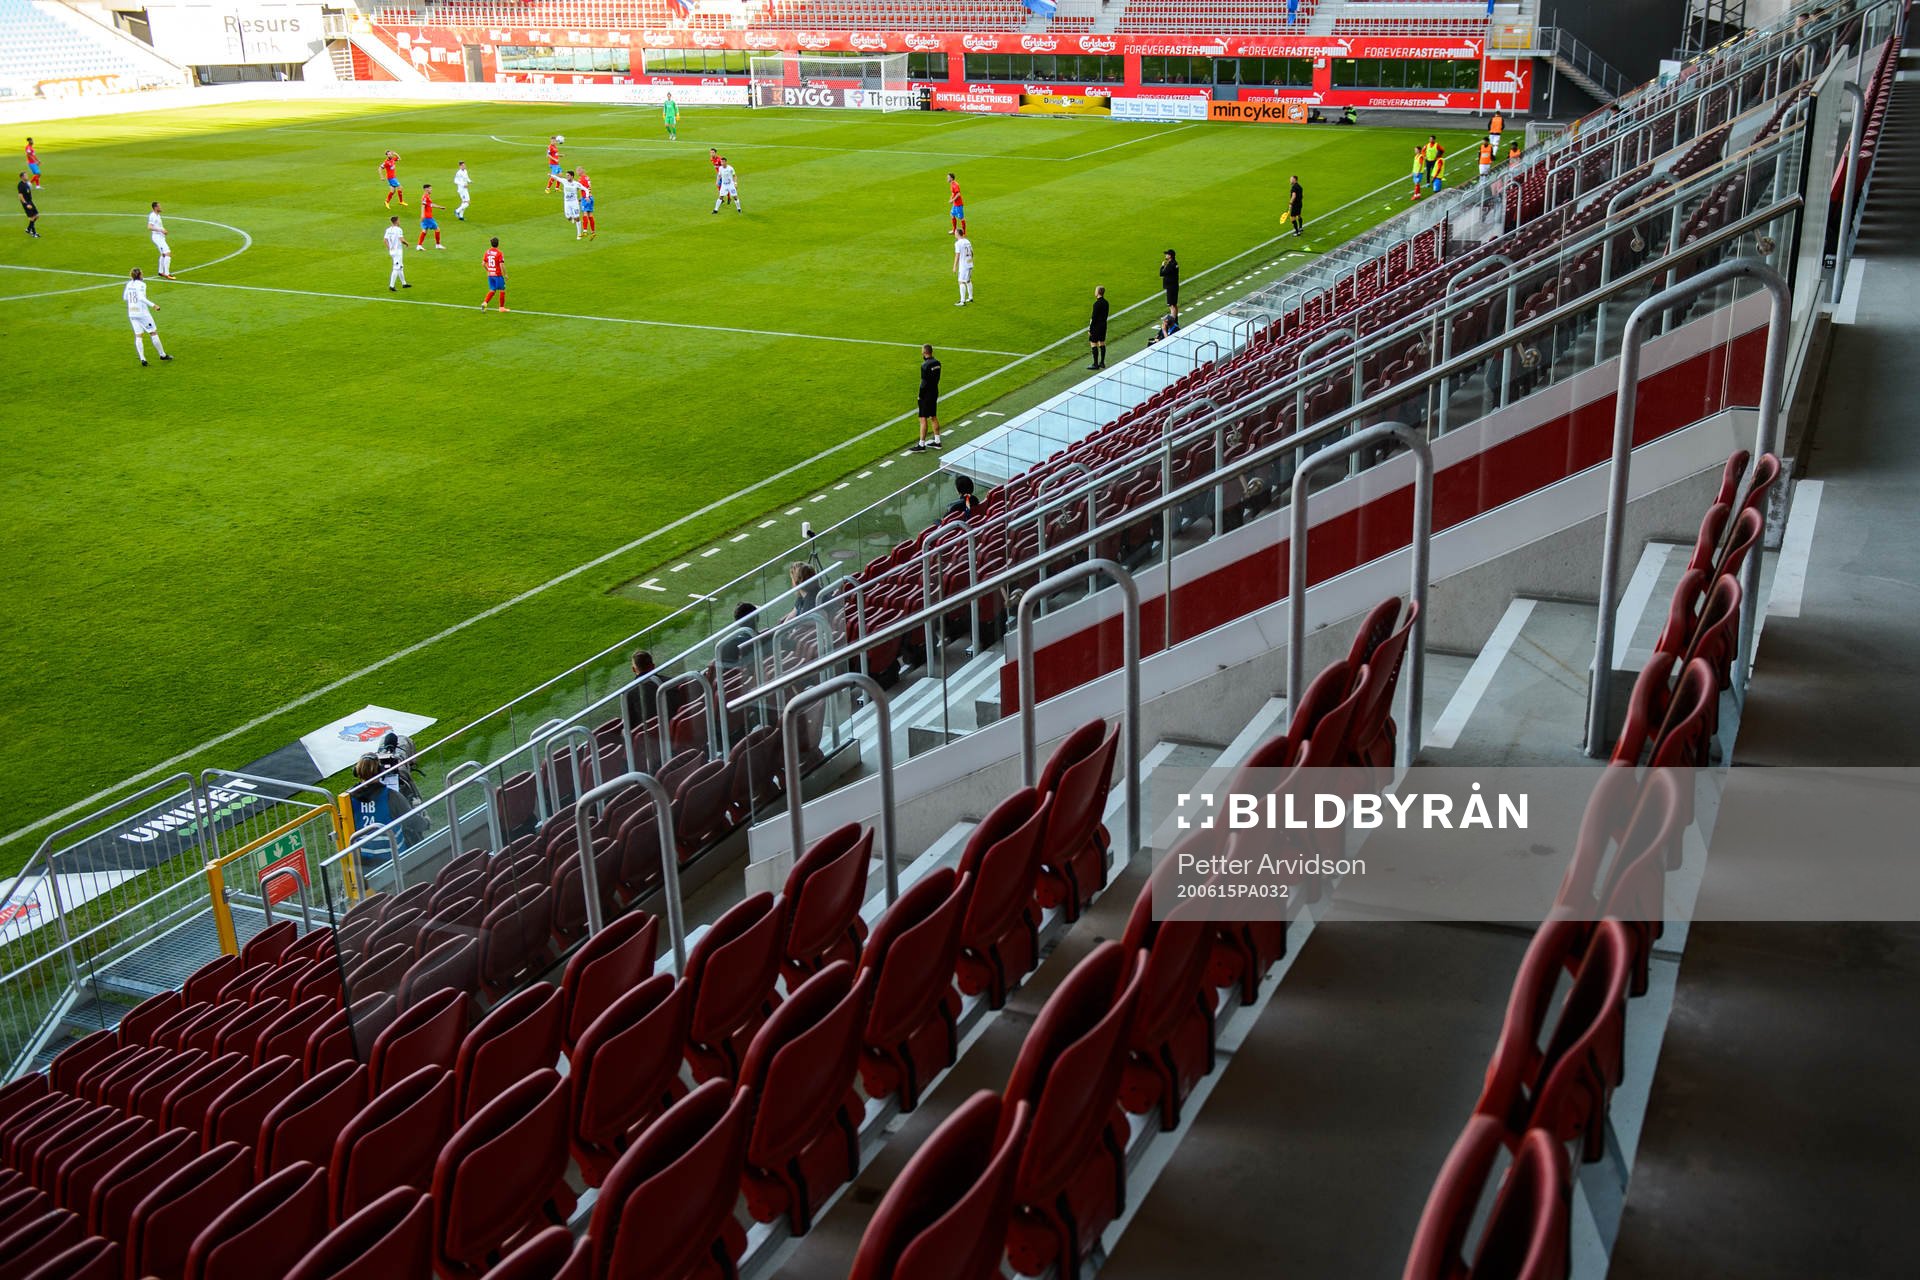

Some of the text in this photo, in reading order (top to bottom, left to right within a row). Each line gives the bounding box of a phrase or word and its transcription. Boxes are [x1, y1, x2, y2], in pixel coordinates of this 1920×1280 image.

[223, 15, 301, 33] Resurs
[797, 31, 830, 48] Carlsberg
[850, 32, 884, 49] Carlsberg
[905, 34, 940, 50] Carlsberg
[963, 34, 999, 51] Carlsberg
[1020, 34, 1057, 53] Carlsberg
[1079, 36, 1116, 53] Carlsberg
[784, 87, 834, 106] BYGG
[969, 84, 995, 94] Carlsberg
[1027, 85, 1053, 96] Carlsberg
[1085, 86, 1112, 98] Carlsberg
[868, 91, 922, 107] Thermia
[936, 93, 1013, 105] RIKTIGA ELEKTRIKER
[1213, 103, 1241, 117] min
[1243, 104, 1286, 121] cykel
[487, 255, 496, 268] 15
[129, 291, 138, 304] 18
[119, 777, 258, 843] UNIBET
[360, 800, 376, 813] HB
